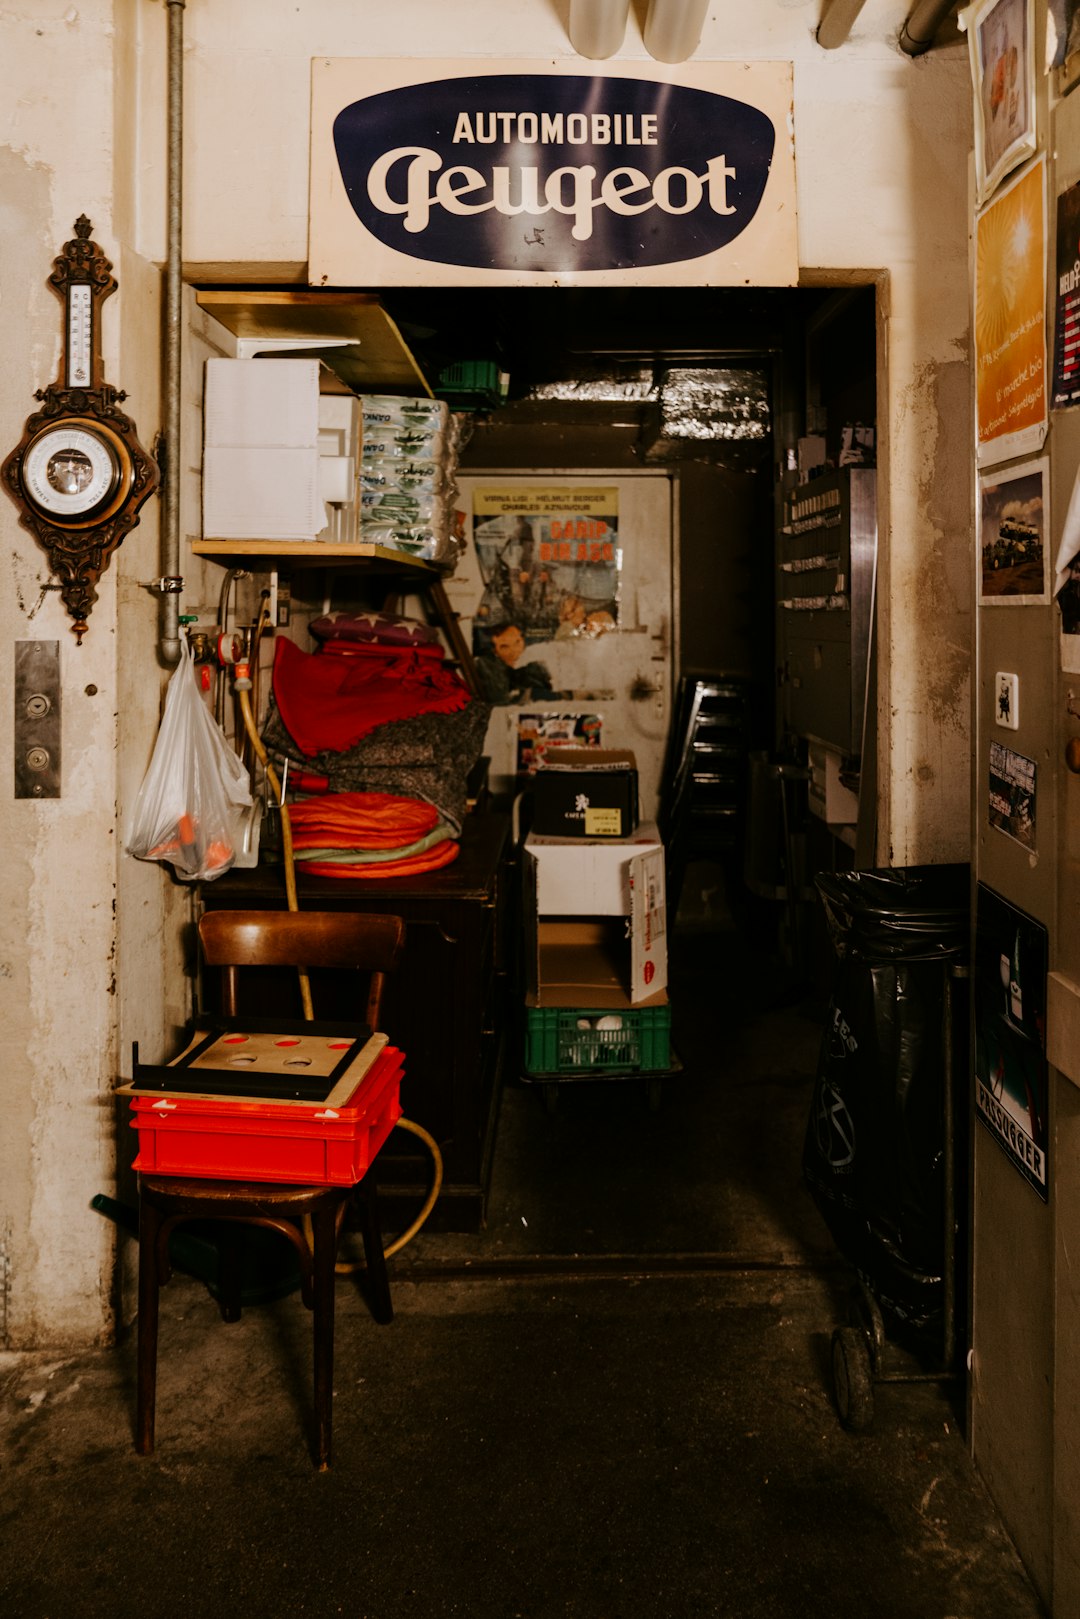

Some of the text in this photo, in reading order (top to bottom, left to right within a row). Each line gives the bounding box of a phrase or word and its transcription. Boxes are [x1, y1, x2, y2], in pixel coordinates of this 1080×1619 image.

[452, 111, 659, 146] AUTOMOBILE
[366, 146, 739, 241] Peugeot
[550, 520, 607, 539] GARIP
[979, 1083, 1041, 1177] PASSUGGER
